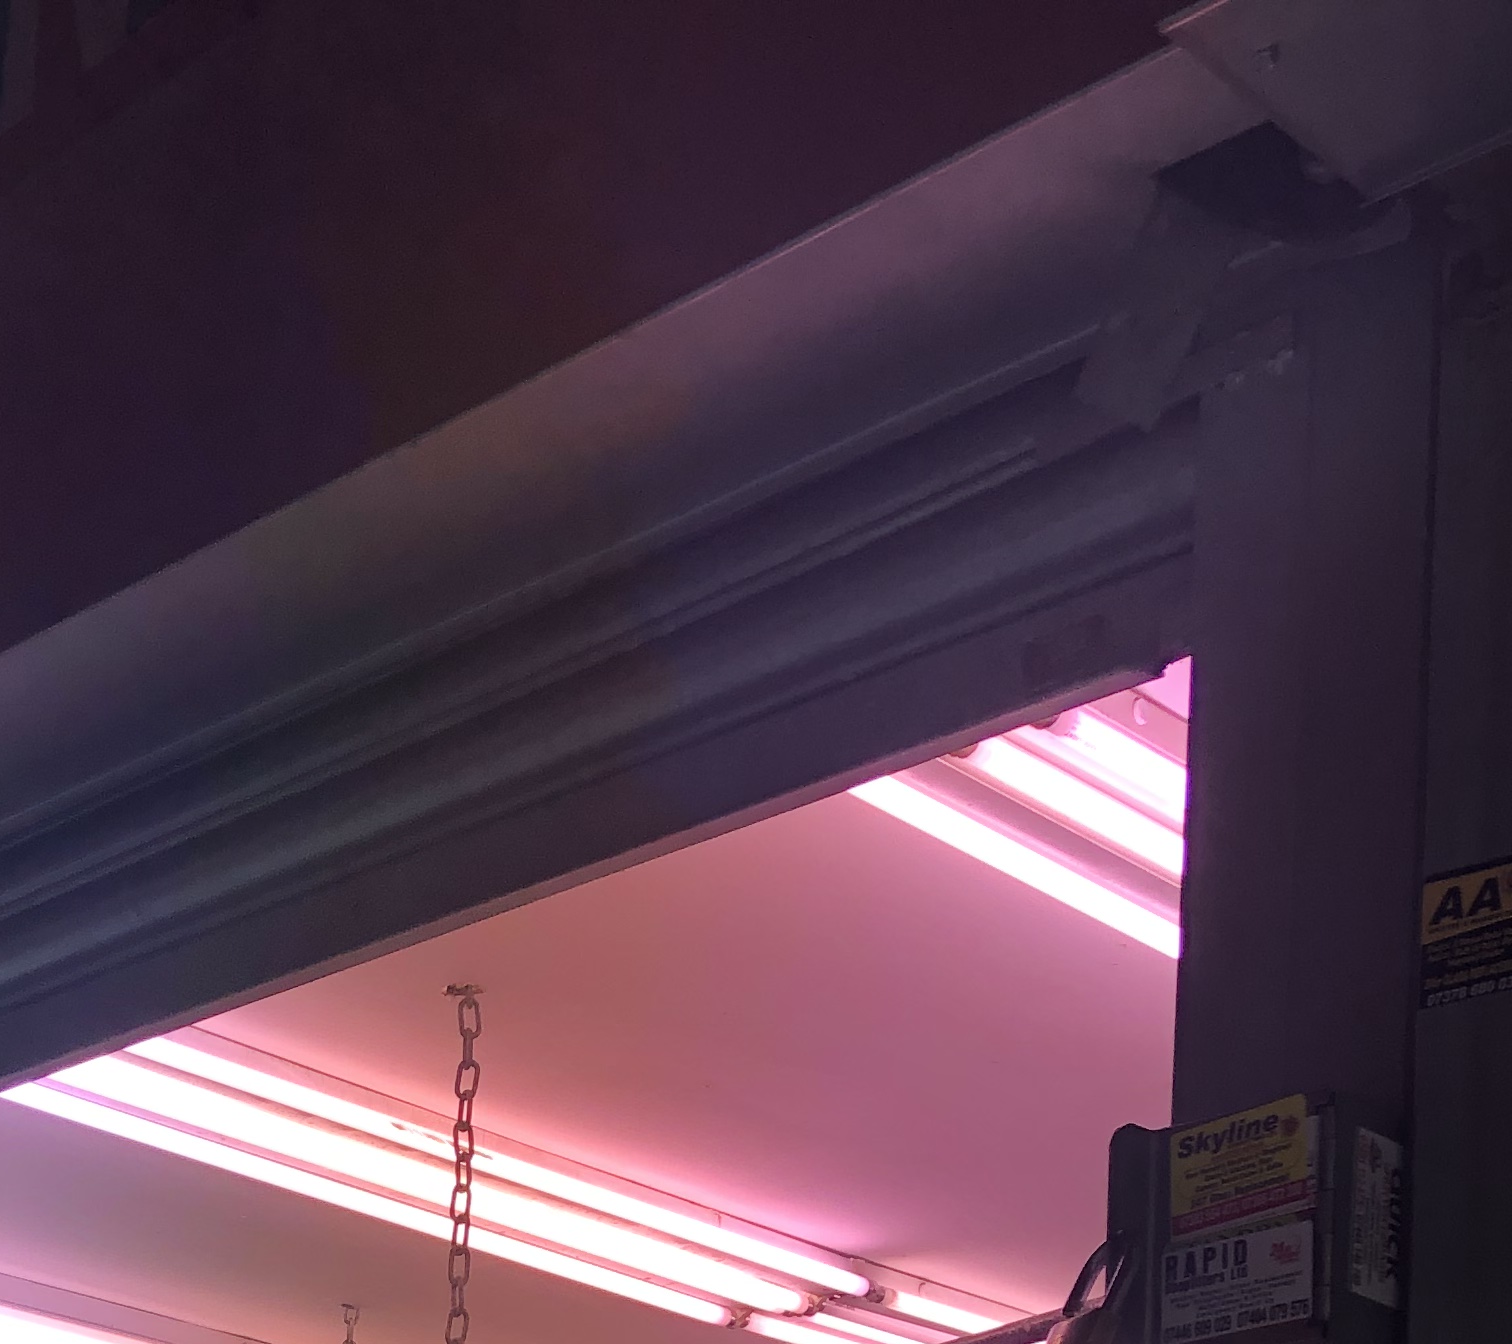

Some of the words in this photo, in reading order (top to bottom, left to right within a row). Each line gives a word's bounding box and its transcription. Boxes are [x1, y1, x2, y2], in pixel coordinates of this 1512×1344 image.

[1430, 877, 1501, 925] AA
[1178, 1114, 1279, 1158] Skyline
[1166, 1240, 1248, 1280] RAPID
